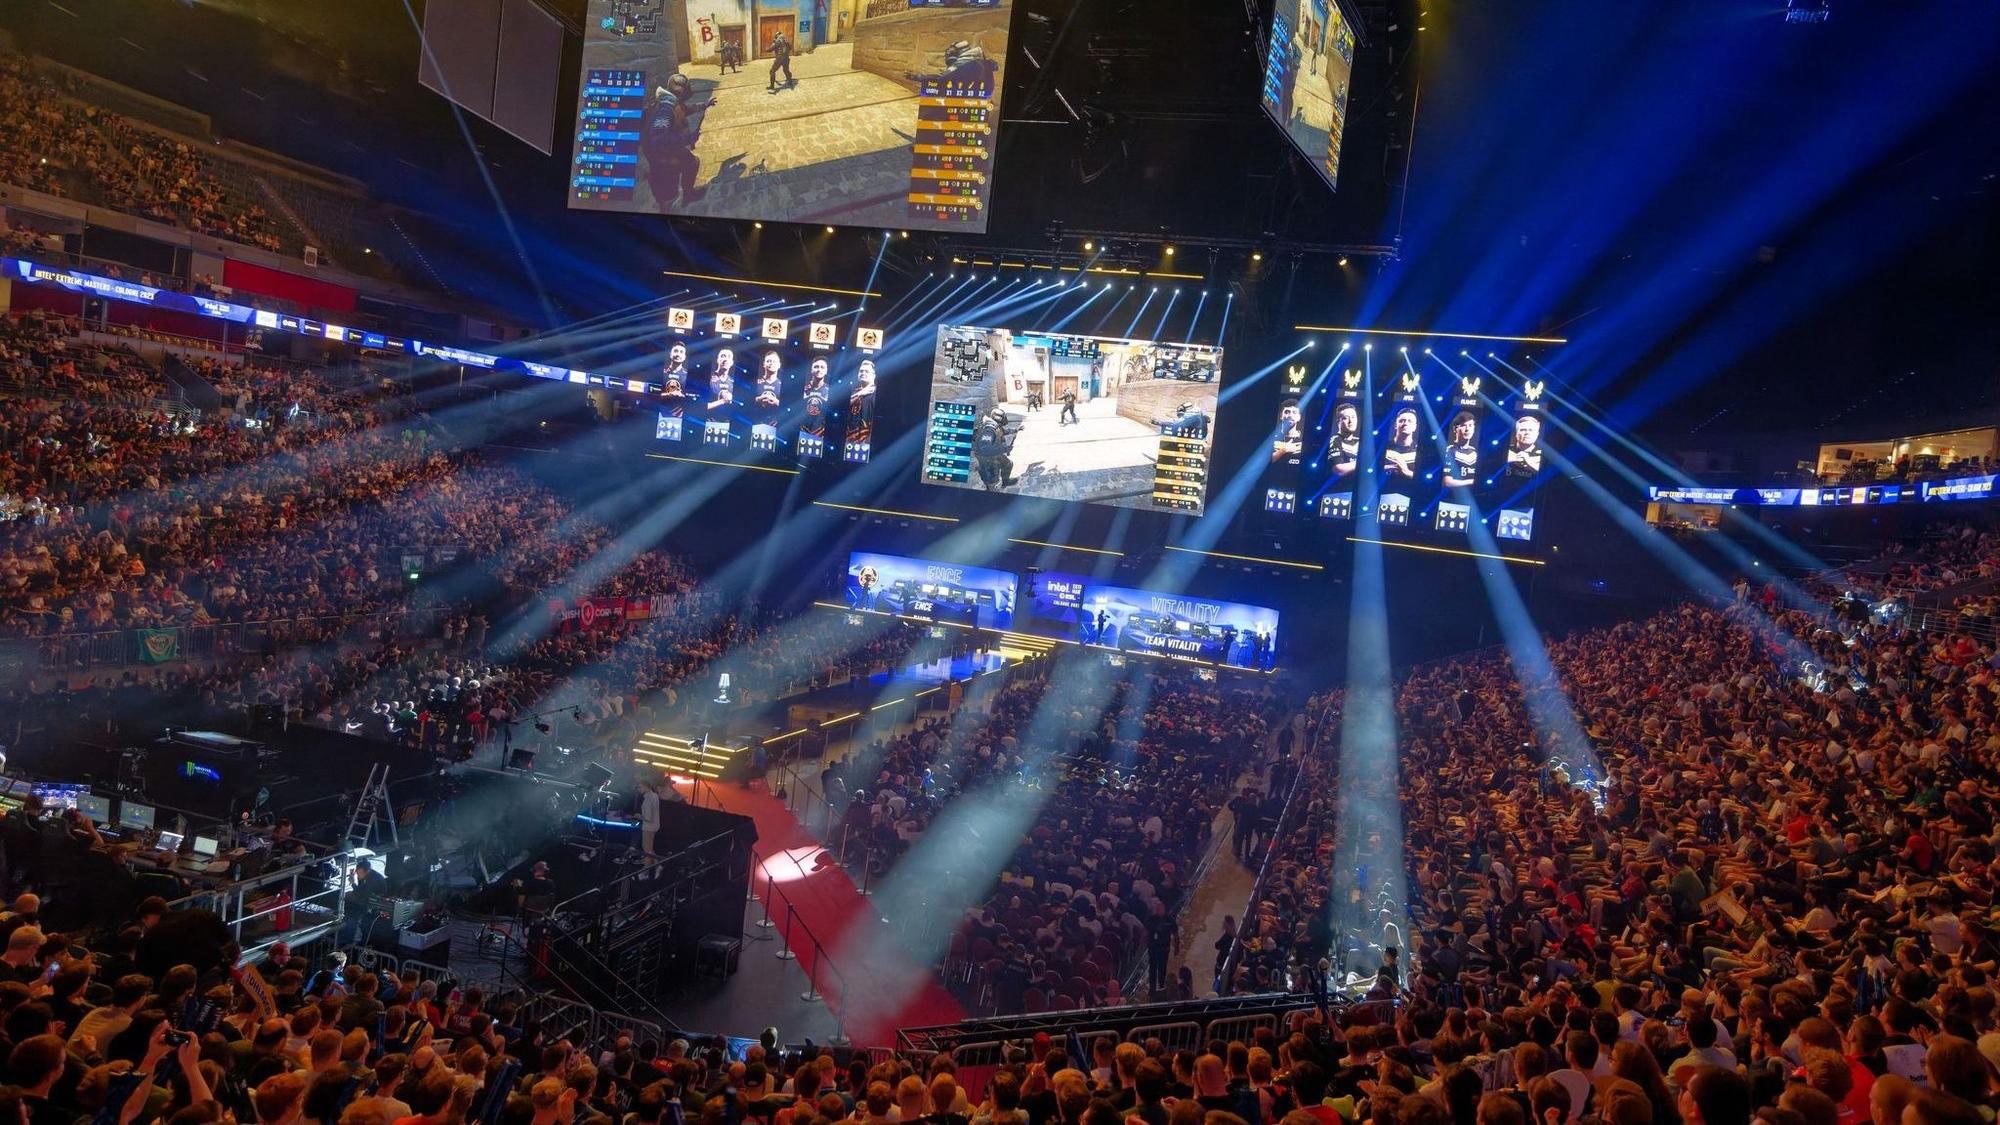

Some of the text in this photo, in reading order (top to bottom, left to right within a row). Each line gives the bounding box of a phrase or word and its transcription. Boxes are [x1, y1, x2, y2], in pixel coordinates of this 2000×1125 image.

[701, 26, 713, 43] B
[56, 274, 82, 286] EXTREME
[84, 279, 110, 291] MASTERS
[115, 285, 139, 297] COLOGNE
[927, 565, 962, 586] ENCE
[914, 600, 934, 612] ENCE
[1152, 596, 1220, 623] VITALITY
[1145, 635, 1202, 652] TEAM VITALITY
